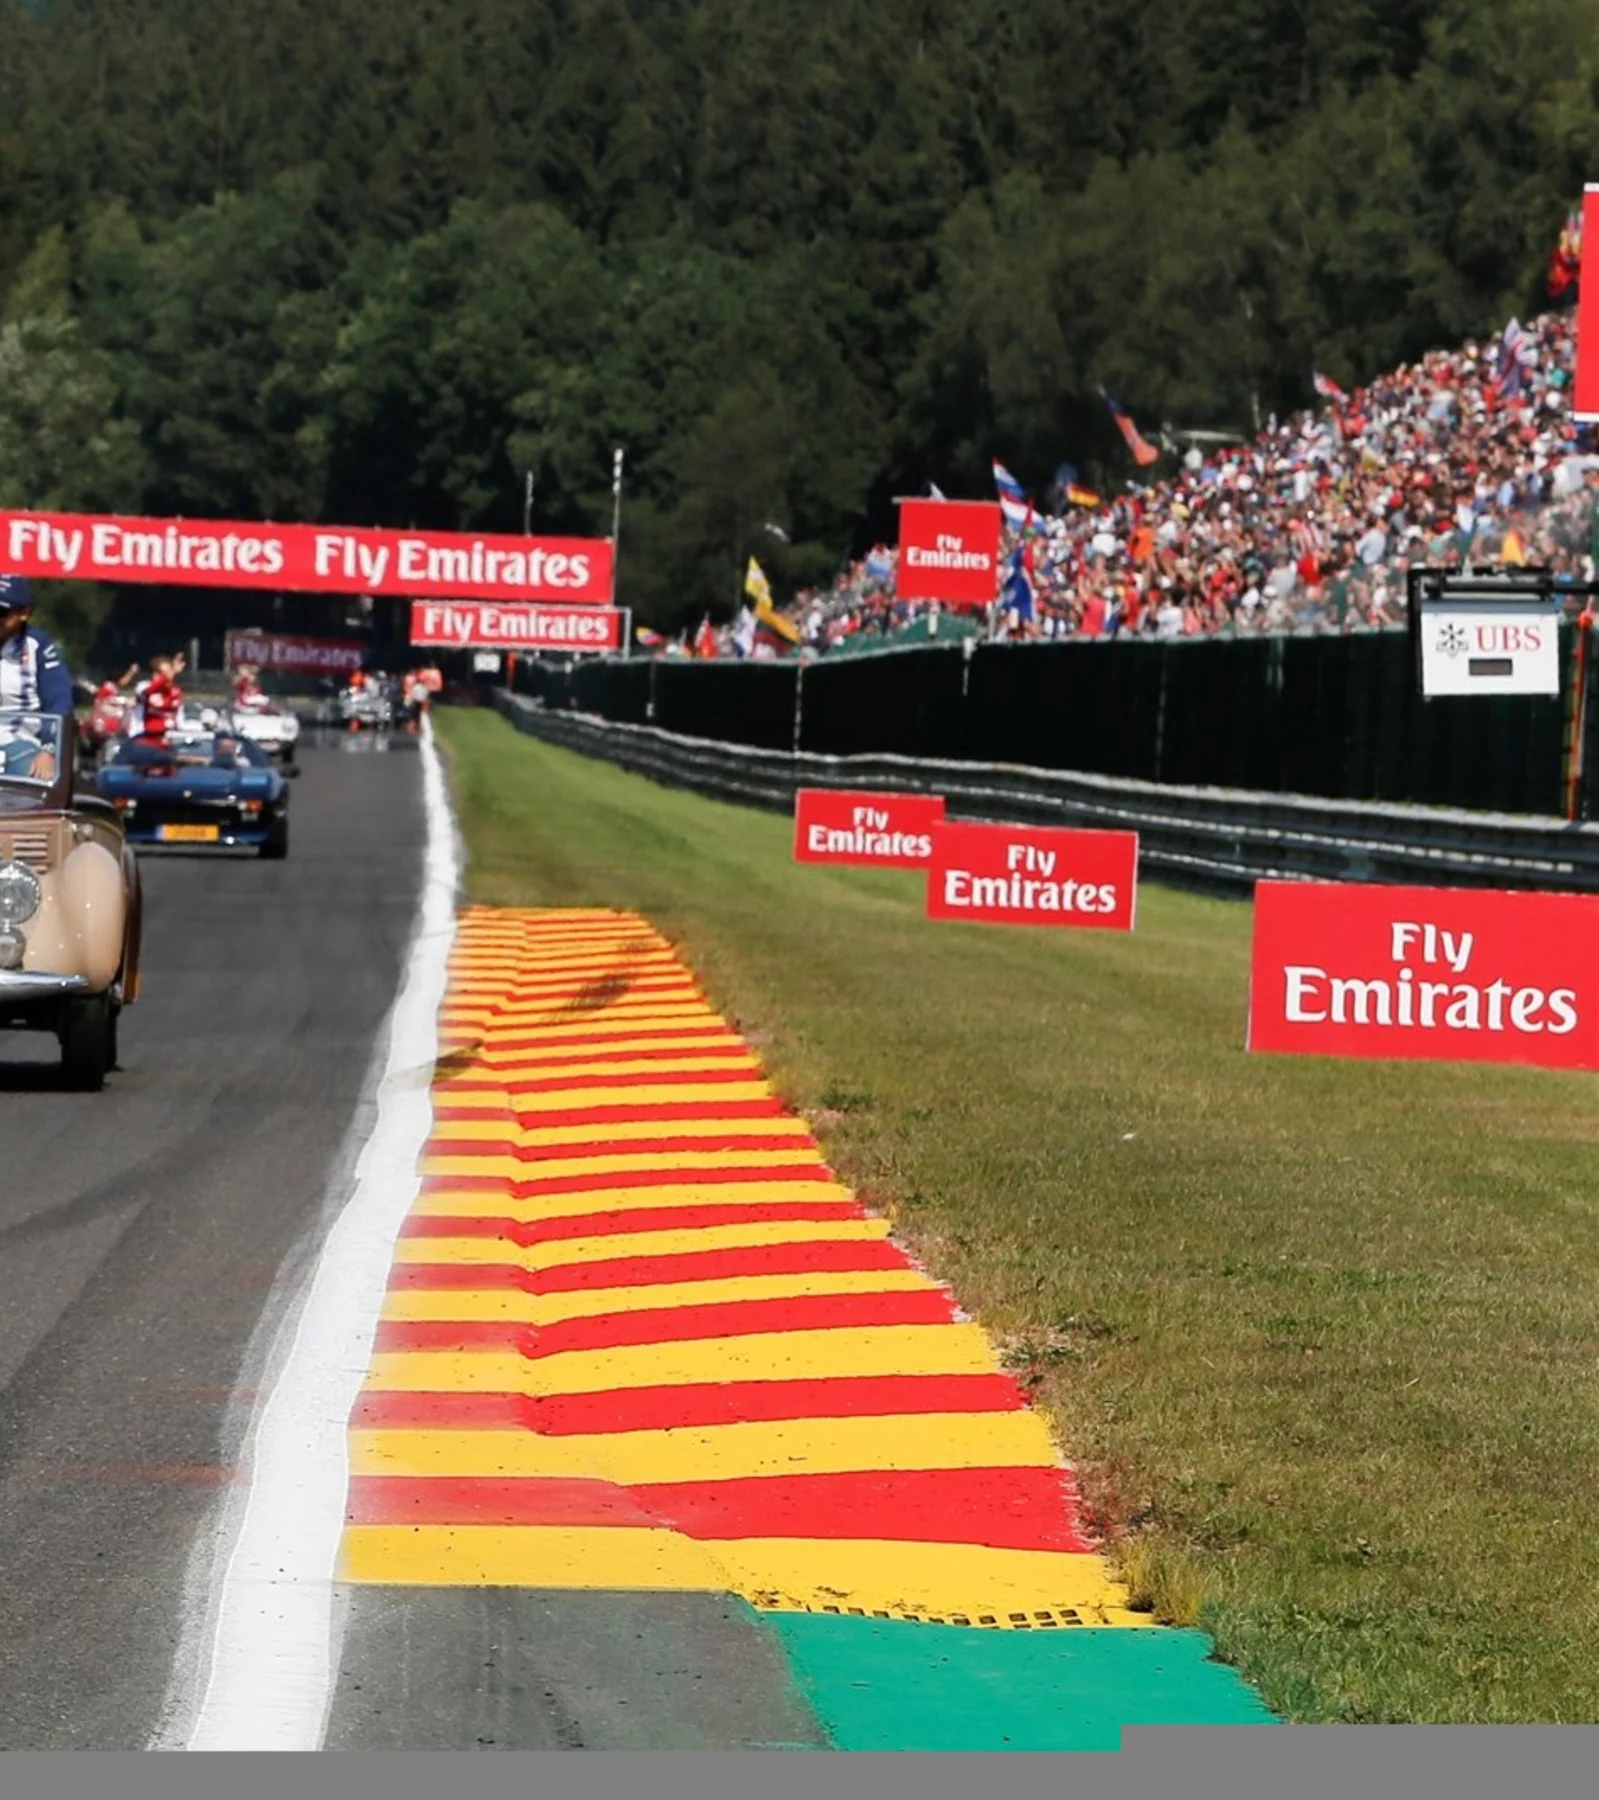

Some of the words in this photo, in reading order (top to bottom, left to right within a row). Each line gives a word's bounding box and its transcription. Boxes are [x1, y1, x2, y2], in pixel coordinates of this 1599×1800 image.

[9, 519, 84, 572] Fly
[91, 524, 284, 574] Emirates
[314, 535, 390, 588] Fly
[397, 540, 590, 588] Emirates
[906, 547, 991, 570] Emirates
[937, 534, 963, 552] Fly
[424, 609, 475, 642] Fly
[480, 610, 610, 641] Emirates
[1474, 624, 1542, 653] UBS
[233, 638, 270, 664] Fly
[273, 640, 363, 667] Emirates
[852, 805, 890, 831] Fly
[808, 823, 932, 858] Emirates
[1007, 844, 1056, 877] Fly
[944, 869, 1117, 913] Emirates
[1391, 922, 1474, 973] Fly
[1283, 966, 1578, 1034] Emirates
